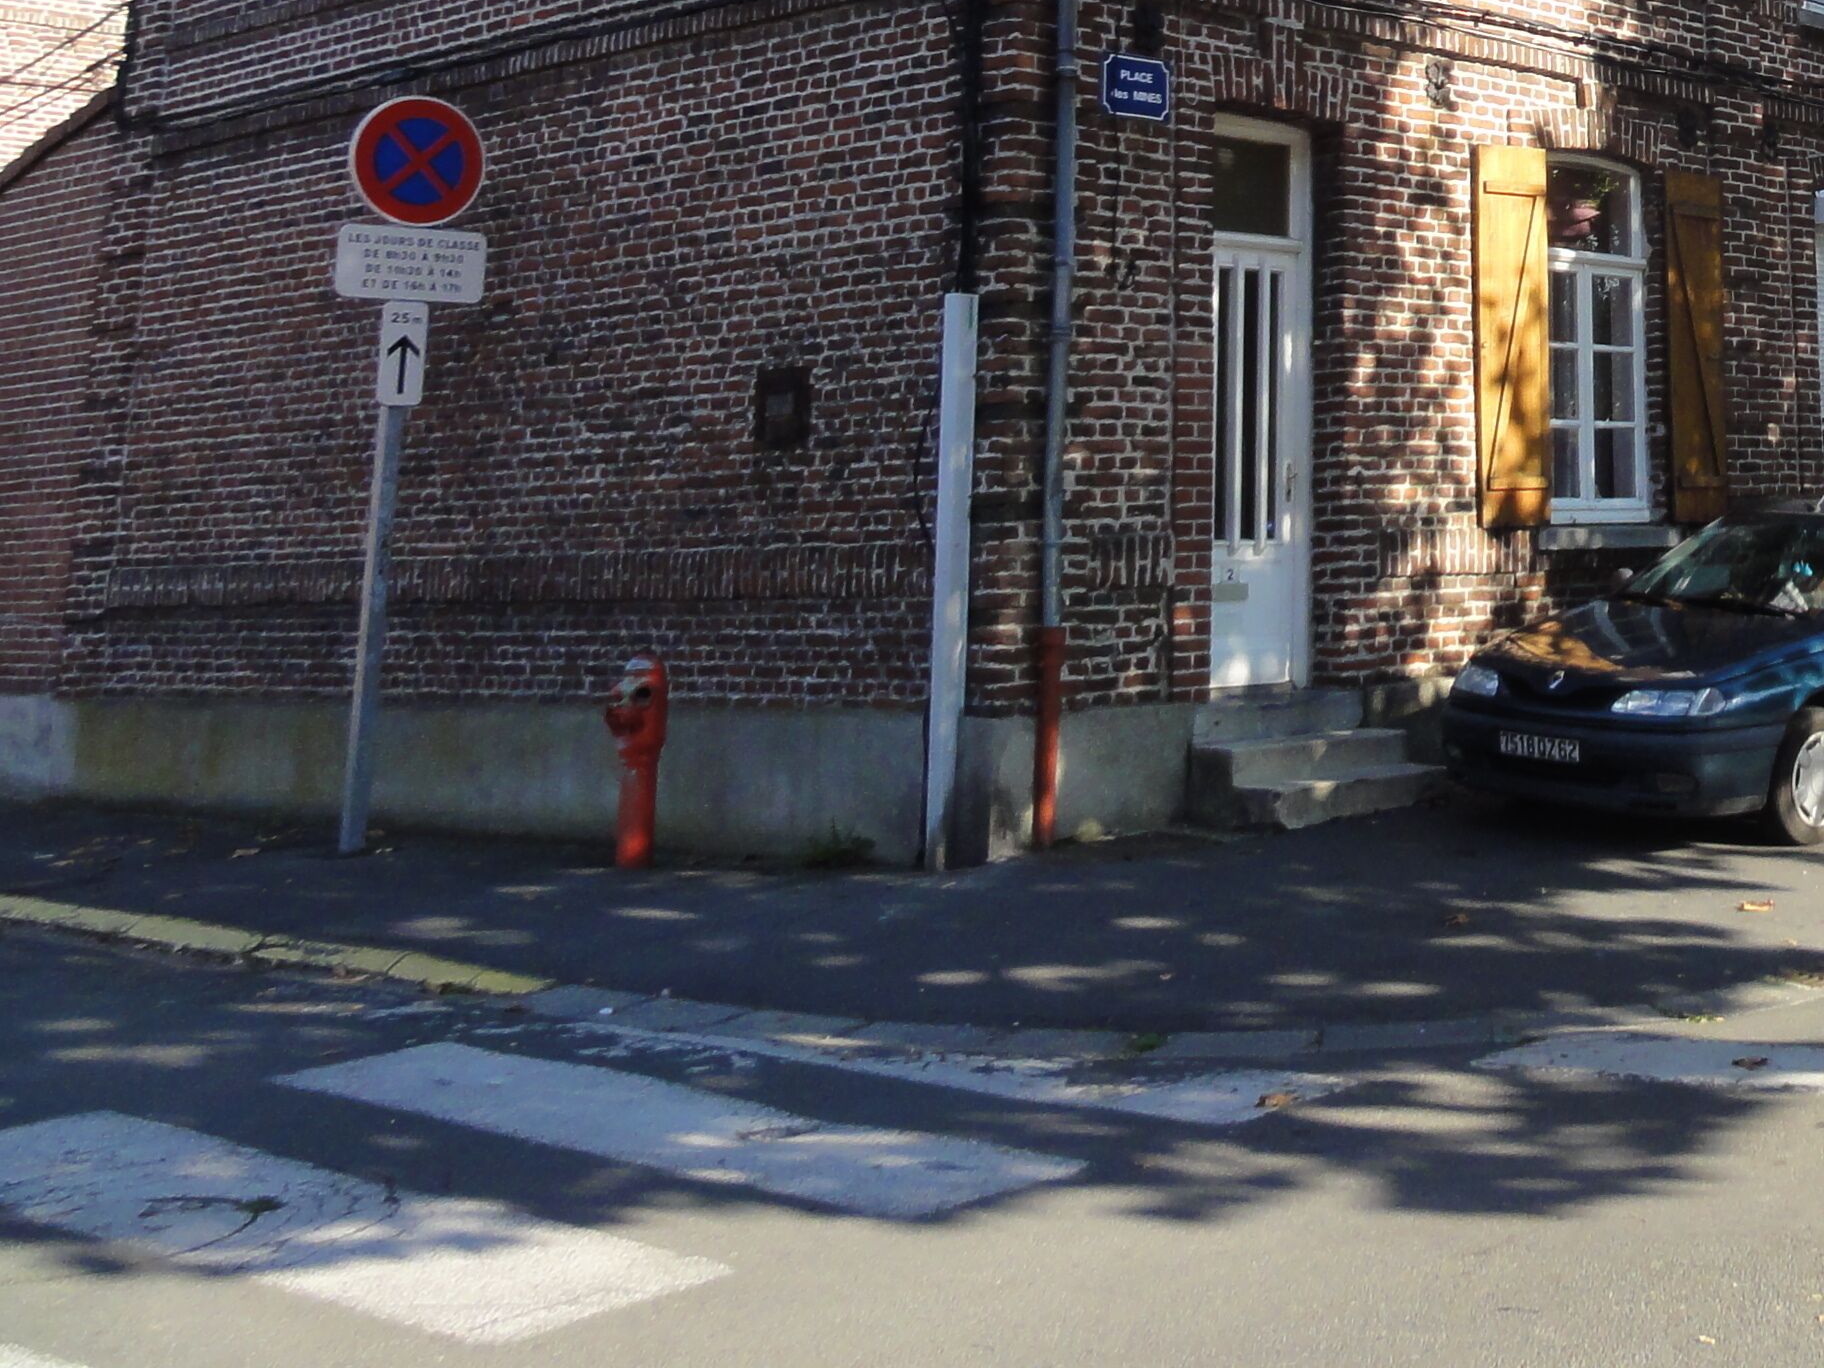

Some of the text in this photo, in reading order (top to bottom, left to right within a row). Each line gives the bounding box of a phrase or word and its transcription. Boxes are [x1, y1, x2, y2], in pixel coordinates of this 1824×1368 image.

[1120, 69, 1154, 84] PLACE
[1133, 90, 1162, 104] MINES
[348, 233, 480, 251] LES JOURS DE CLASSE
[364, 248, 379, 258] DE
[365, 263, 381, 274] DE
[361, 278, 377, 289] ET
[382, 279, 399, 290] DE
[1227, 568, 1234, 581] 2
